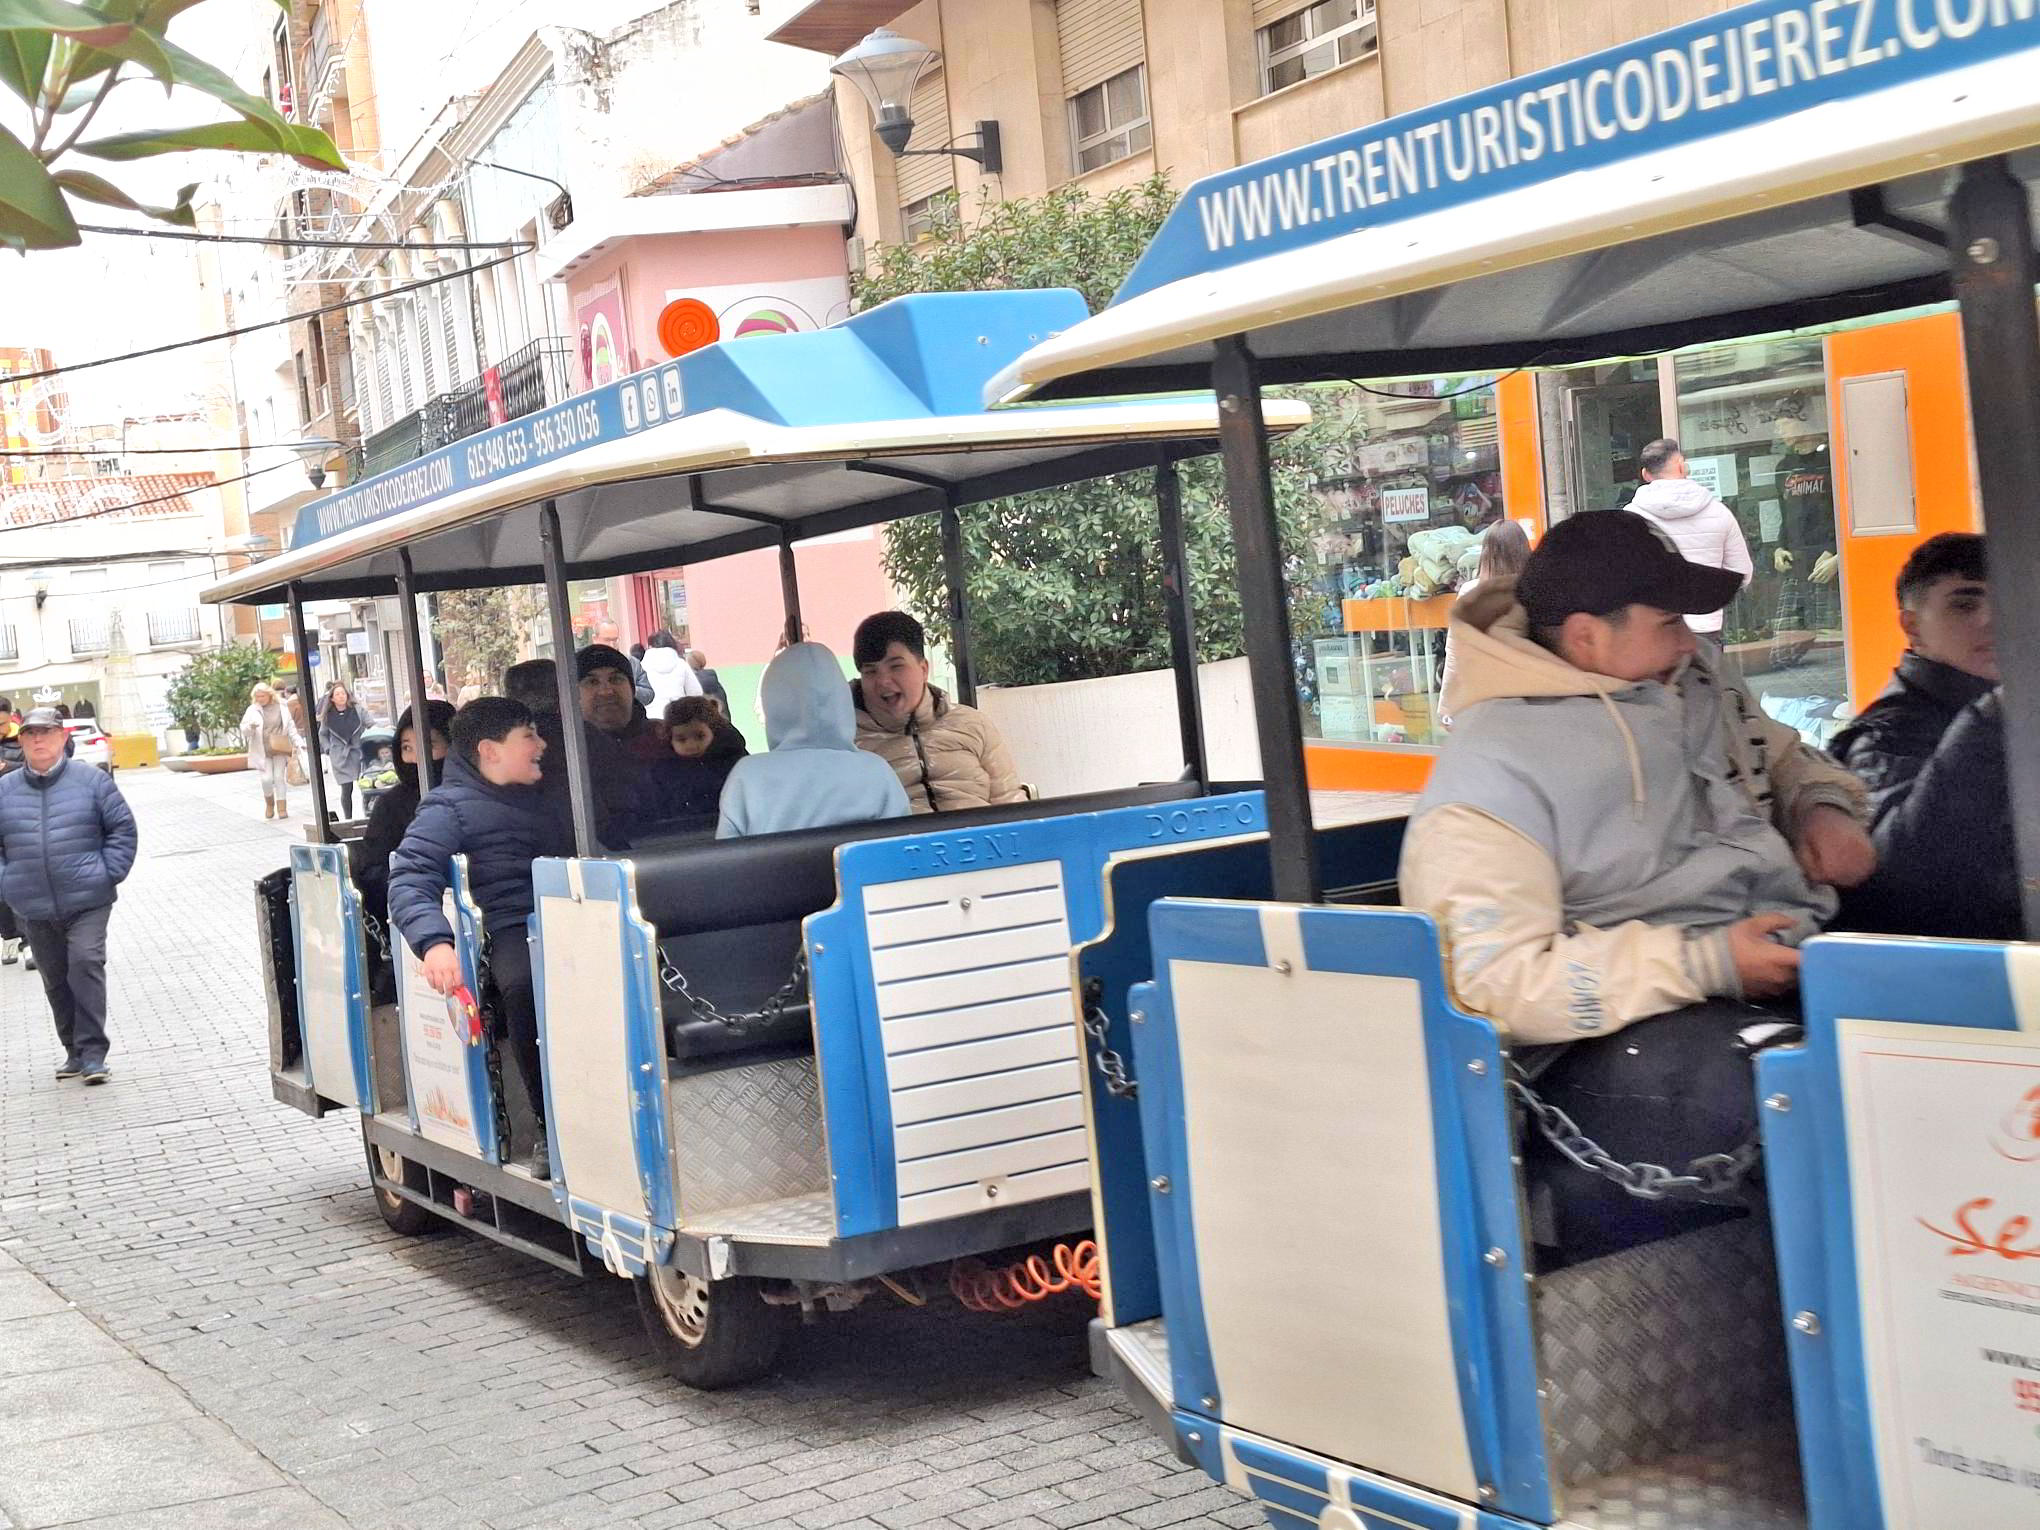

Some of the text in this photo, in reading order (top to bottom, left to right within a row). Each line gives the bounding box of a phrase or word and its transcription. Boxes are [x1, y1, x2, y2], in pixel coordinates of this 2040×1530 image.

[467, 443, 487, 480] 615
[485, 434, 506, 473] 948
[506, 427, 527, 466] 653
[533, 416, 554, 457] 956
[553, 408, 576, 449] 350
[576, 399, 600, 442] 056
[316, 455, 454, 537] WWW.TRENTURISTICODEJEREZ.COM
[1384, 493, 1425, 516] PELUCHES
[903, 801, 1254, 871] TRENI DOTTO
